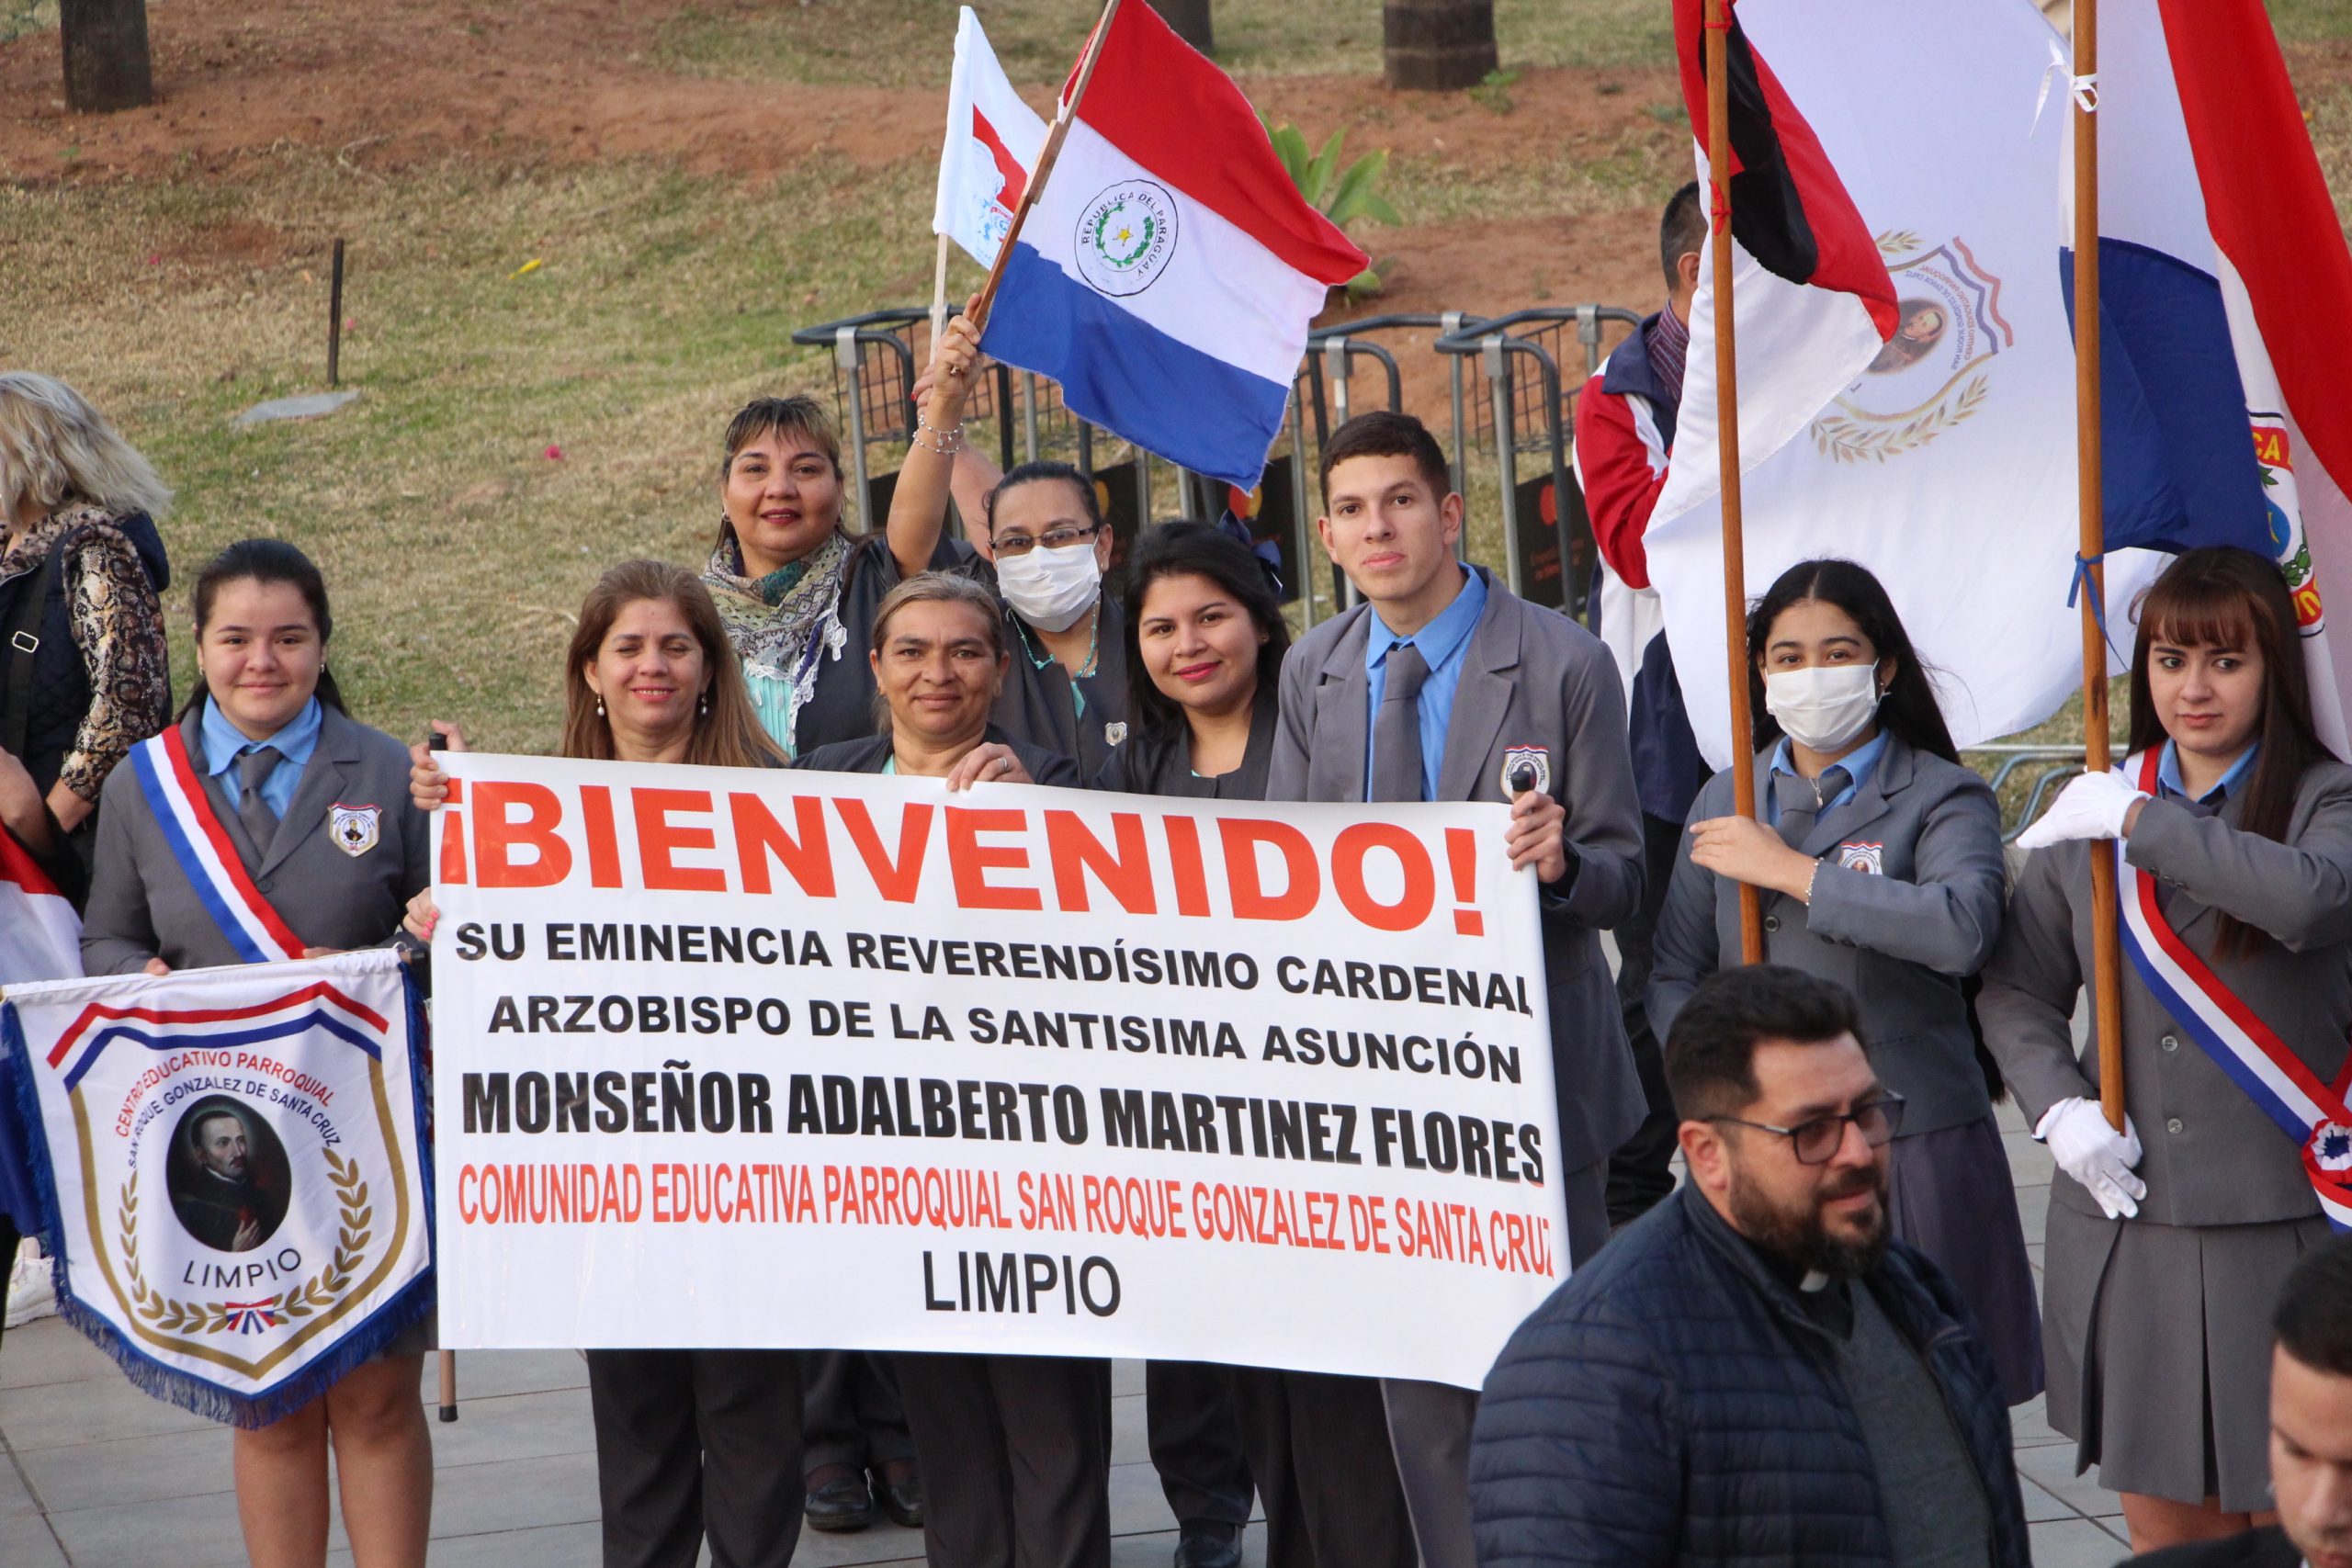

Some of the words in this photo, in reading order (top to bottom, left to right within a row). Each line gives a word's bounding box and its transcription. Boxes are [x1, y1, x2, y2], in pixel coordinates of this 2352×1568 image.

[1137, 209, 1167, 276] PARAGUAY
[1138, 193, 1157, 209] DEL
[456, 922, 526, 961] SU
[546, 923, 832, 967] EMINENCIA
[846, 931, 1259, 990] REVERENDÍSIMO
[1276, 956, 1532, 1018] CARDENAL
[488, 995, 791, 1036] ARZOBISPO
[808, 999, 875, 1038] DE
[890, 1003, 955, 1042] LA
[967, 1008, 1247, 1059] SANTISIMA
[1262, 1025, 1521, 1084] ASUNCIÓN
[115, 1080, 144, 1138] CENTRO
[142, 1051, 231, 1089] EDUCATIVO
[236, 1052, 334, 1108] PARROQUIAL
[128, 1138, 140, 1169] SAN
[134, 1100, 164, 1140] ROQUE
[163, 1076, 241, 1106] GONZALEZ
[245, 1080, 266, 1098] DE
[268, 1088, 314, 1119] SANTA
[311, 1110, 342, 1148] CRUZ
[462, 1059, 773, 1134] MONSEÑOR
[787, 1074, 1089, 1145] ADALBERTO
[1100, 1088, 1362, 1165] MARTINEZ
[1371, 1108, 1544, 1188] FLORES
[458, 1162, 642, 1224] COMUNIDAD
[652, 1162, 819, 1224] EDUCATIVA
[823, 1165, 1013, 1231] PARROQUIAL
[1017, 1170, 1078, 1232] SAN
[1082, 1175, 1188, 1240] ROQUE
[1192, 1181, 1346, 1250] GONZALEZ
[1348, 1194, 1391, 1254] DE
[1395, 1197, 1487, 1266] SANTA
[183, 1247, 301, 1289] LIMPIO
[923, 1250, 1121, 1317] LIMPIO
